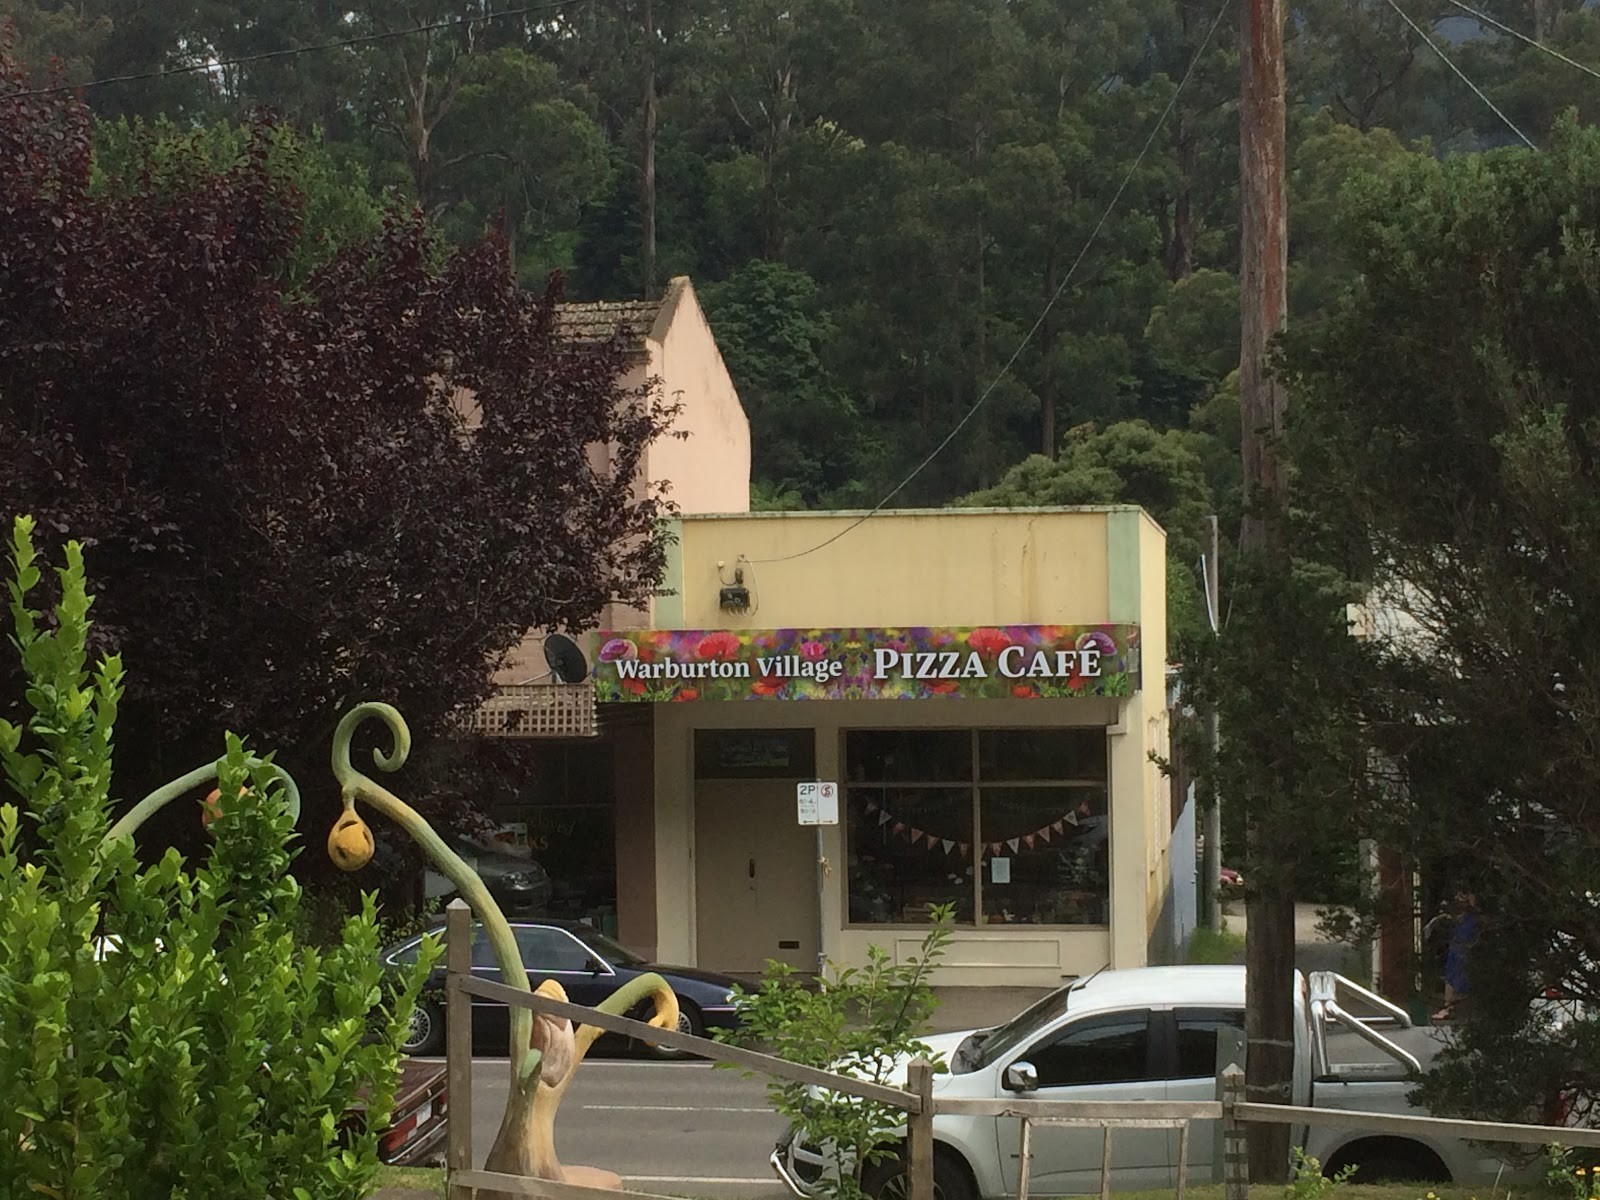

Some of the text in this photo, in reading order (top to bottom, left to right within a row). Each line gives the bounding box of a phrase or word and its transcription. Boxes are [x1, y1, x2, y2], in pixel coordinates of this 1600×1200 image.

[615, 640, 1102, 682] Warburton Village PIZZA CAFÉ
[800, 785, 816, 795] 2P
